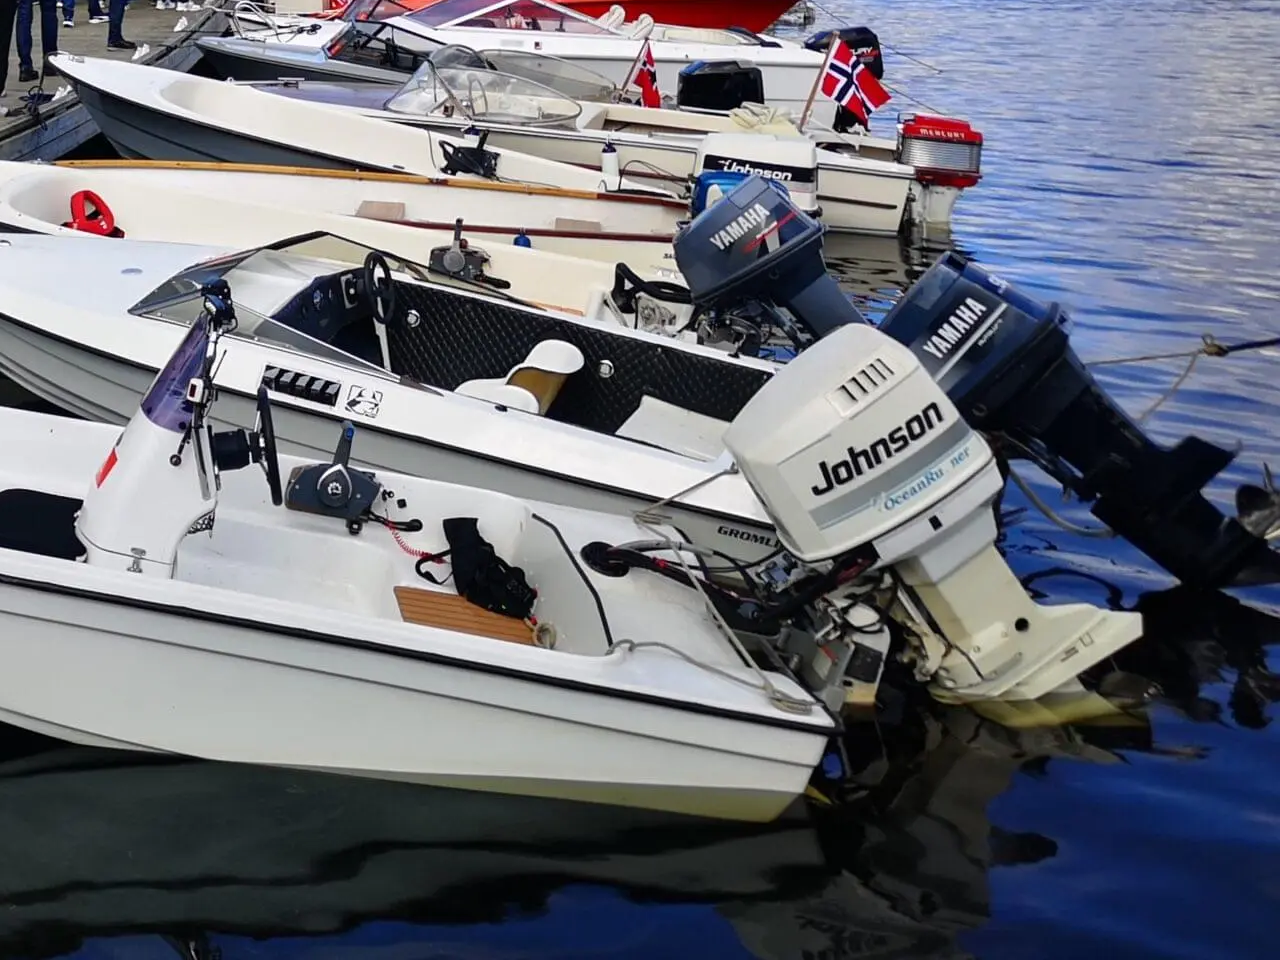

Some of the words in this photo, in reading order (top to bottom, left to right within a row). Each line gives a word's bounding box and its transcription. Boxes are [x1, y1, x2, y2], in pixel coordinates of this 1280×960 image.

[920, 128, 965, 139] MERCURY
[721, 160, 792, 181] Johnson
[709, 203, 770, 250] YAMAHA
[923, 297, 987, 358] YAMAHA
[811, 402, 943, 496] Johnson
[884, 446, 971, 511] OceanRuner
